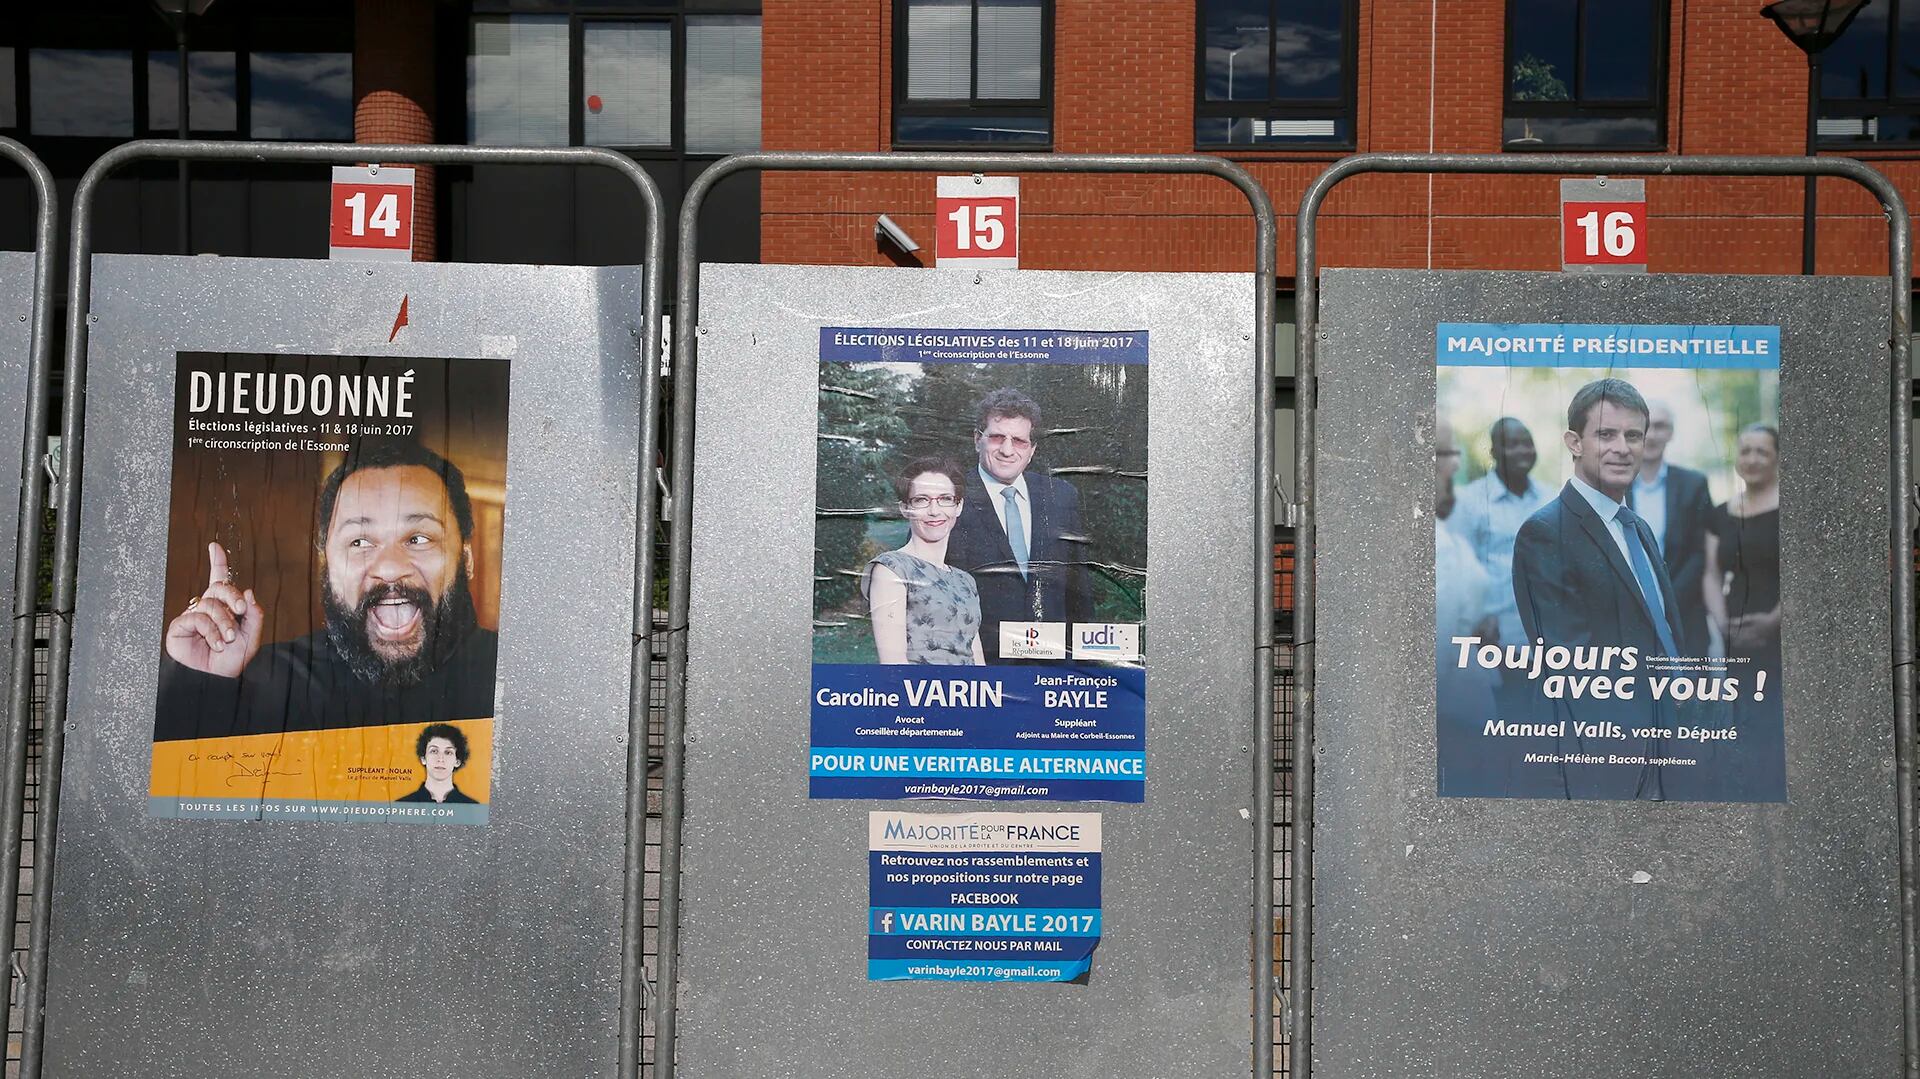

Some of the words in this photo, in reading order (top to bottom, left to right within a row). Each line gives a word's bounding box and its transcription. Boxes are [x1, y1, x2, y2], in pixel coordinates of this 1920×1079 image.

[345, 192, 400, 237] 14
[949, 205, 1004, 250] 15
[1577, 211, 1635, 256] 16
[835, 334, 905, 348] ÉLECTIONS
[908, 334, 995, 348] LÉGISLATIVES
[998, 336, 1020, 348] des
[1023, 337, 1038, 348] 11
[1041, 338, 1054, 348] et
[1057, 337, 1073, 348] 18
[1073, 337, 1099, 351] juin
[1102, 337, 1133, 348] 2017
[1448, 334, 1565, 356] MAJORITÉ
[1573, 334, 1768, 355] PRÉSIDENTIELLE
[933, 350, 996, 360] circonscription
[997, 351, 1008, 359] de
[189, 368, 415, 418] DIEUDONNÉ
[189, 417, 241, 432] Élections
[244, 419, 309, 436] législatives
[319, 423, 330, 435] 11
[334, 424, 342, 435] &
[345, 424, 357, 435] 18
[359, 424, 381, 437] juin
[386, 425, 414, 436] 2017
[188, 438, 203, 449] 1ère
[205, 438, 282, 452] circonscription
[285, 439, 297, 451] de
[1082, 625, 1114, 645] udi
[1012, 648, 1053, 656] Républicains
[1451, 636, 1639, 680] Toujours
[1034, 674, 1118, 689] Jean-François
[1542, 675, 1636, 700] avec
[1648, 677, 1740, 701] vous
[1752, 670, 1768, 702] !
[816, 687, 899, 707] Caroline
[903, 679, 1003, 708] VARIN
[1044, 691, 1107, 709] BAYLE
[895, 715, 925, 724] Avocat
[1054, 718, 1097, 729] Suppléant
[855, 726, 899, 737] Conseillère
[900, 726, 964, 739] départementale
[1016, 731, 1039, 741] Adjoint
[1050, 731, 1068, 739] Maire
[1079, 732, 1136, 740] Corbeil-Essonnes
[1483, 719, 1565, 737] Manuel
[1573, 720, 1627, 741] Valls,
[1631, 726, 1672, 740] votre
[1677, 725, 1738, 743] Député
[811, 755, 865, 772] POUR
[870, 756, 909, 772] UNE
[913, 756, 1014, 773] VERITABLE
[1019, 757, 1143, 774] ALTERNANCE
[1524, 752, 1605, 765] Marie-Hélène
[1609, 753, 1648, 766] Bacon,
[1649, 756, 1697, 767] suppléante
[904, 783, 1049, 797] varinbayle2017@gmail.com
[180, 803, 221, 813] TOUTES
[226, 804, 245, 813] LES
[284, 804, 307, 814] SUR
[884, 819, 979, 841] MAJORITÉ
[981, 832, 991, 840] LA
[1007, 825, 1080, 840] FRANCE
[881, 854, 945, 866] Retrouvez
[947, 857, 969, 867] nos
[971, 854, 1073, 867] rassemblements
[1076, 857, 1089, 867] et
[887, 873, 909, 883] nos
[911, 871, 991, 886] propositions
[993, 874, 1013, 883] sur
[1015, 873, 1049, 884] notre
[1051, 873, 1083, 887] page
[951, 893, 1019, 905] FACEBOOK
[900, 913, 966, 932] VARIN
[972, 913, 1037, 932] BAYLE
[1042, 915, 1094, 933] 2017
[906, 939, 972, 951] CONTACTEZ
[974, 940, 1008, 952] NOUS
[1010, 940, 1032, 952] PAR
[1034, 940, 1063, 952] MAIL
[908, 964, 1061, 979] varinbayle2017@gmail.com
